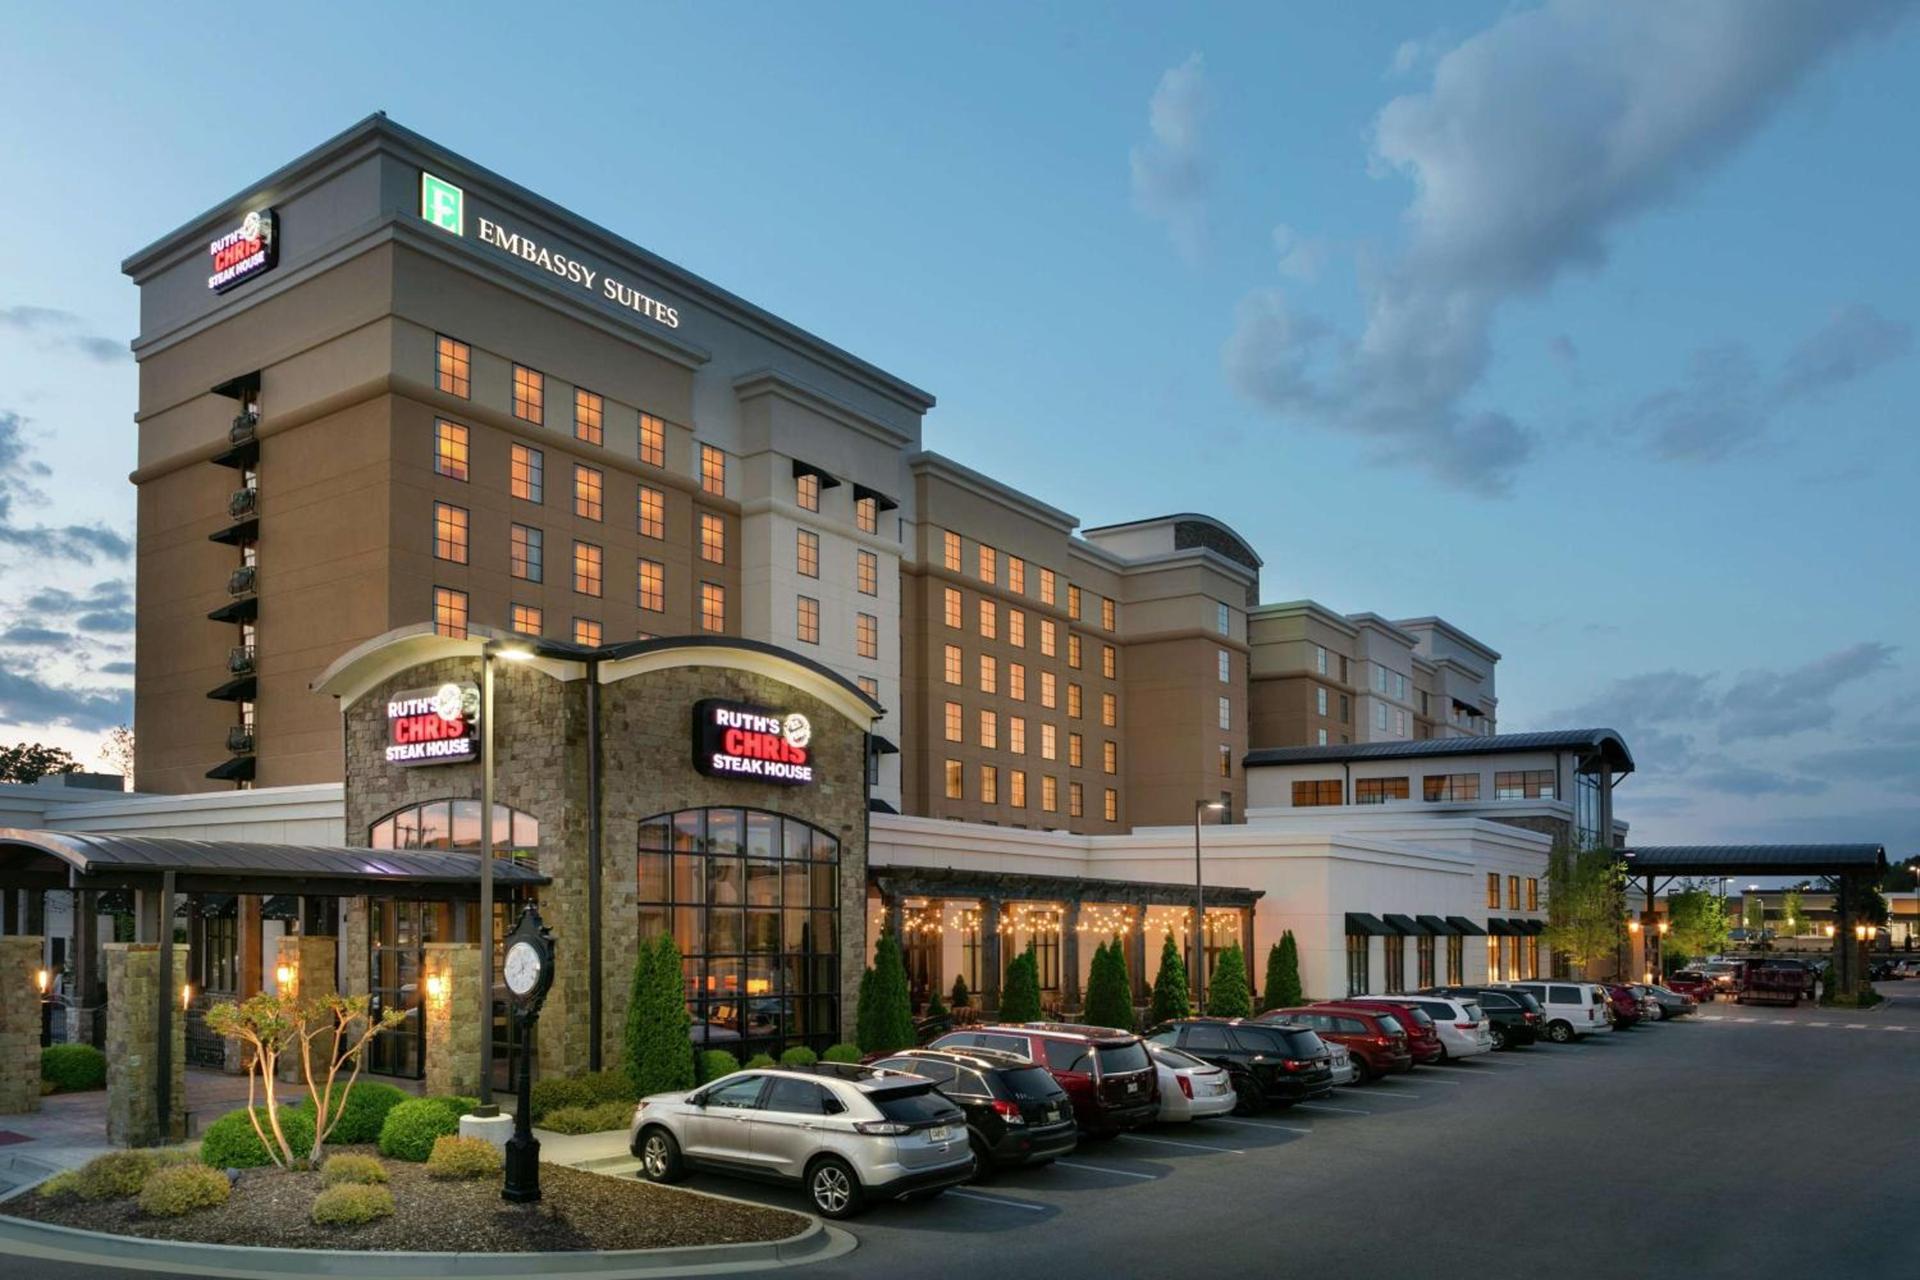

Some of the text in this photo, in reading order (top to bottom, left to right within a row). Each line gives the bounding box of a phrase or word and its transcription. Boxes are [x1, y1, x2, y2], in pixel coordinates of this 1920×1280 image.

[208, 250, 265, 289] STEAK HOUSE
[478, 216, 679, 329] EMBASSY SUITES
[395, 712, 464, 744] CHRIS
[716, 708, 780, 735] RUTH'S
[386, 738, 470, 761] STEAK HOUSE
[725, 728, 807, 764] CHRIS
[713, 753, 812, 781] STEAK HOUSE
